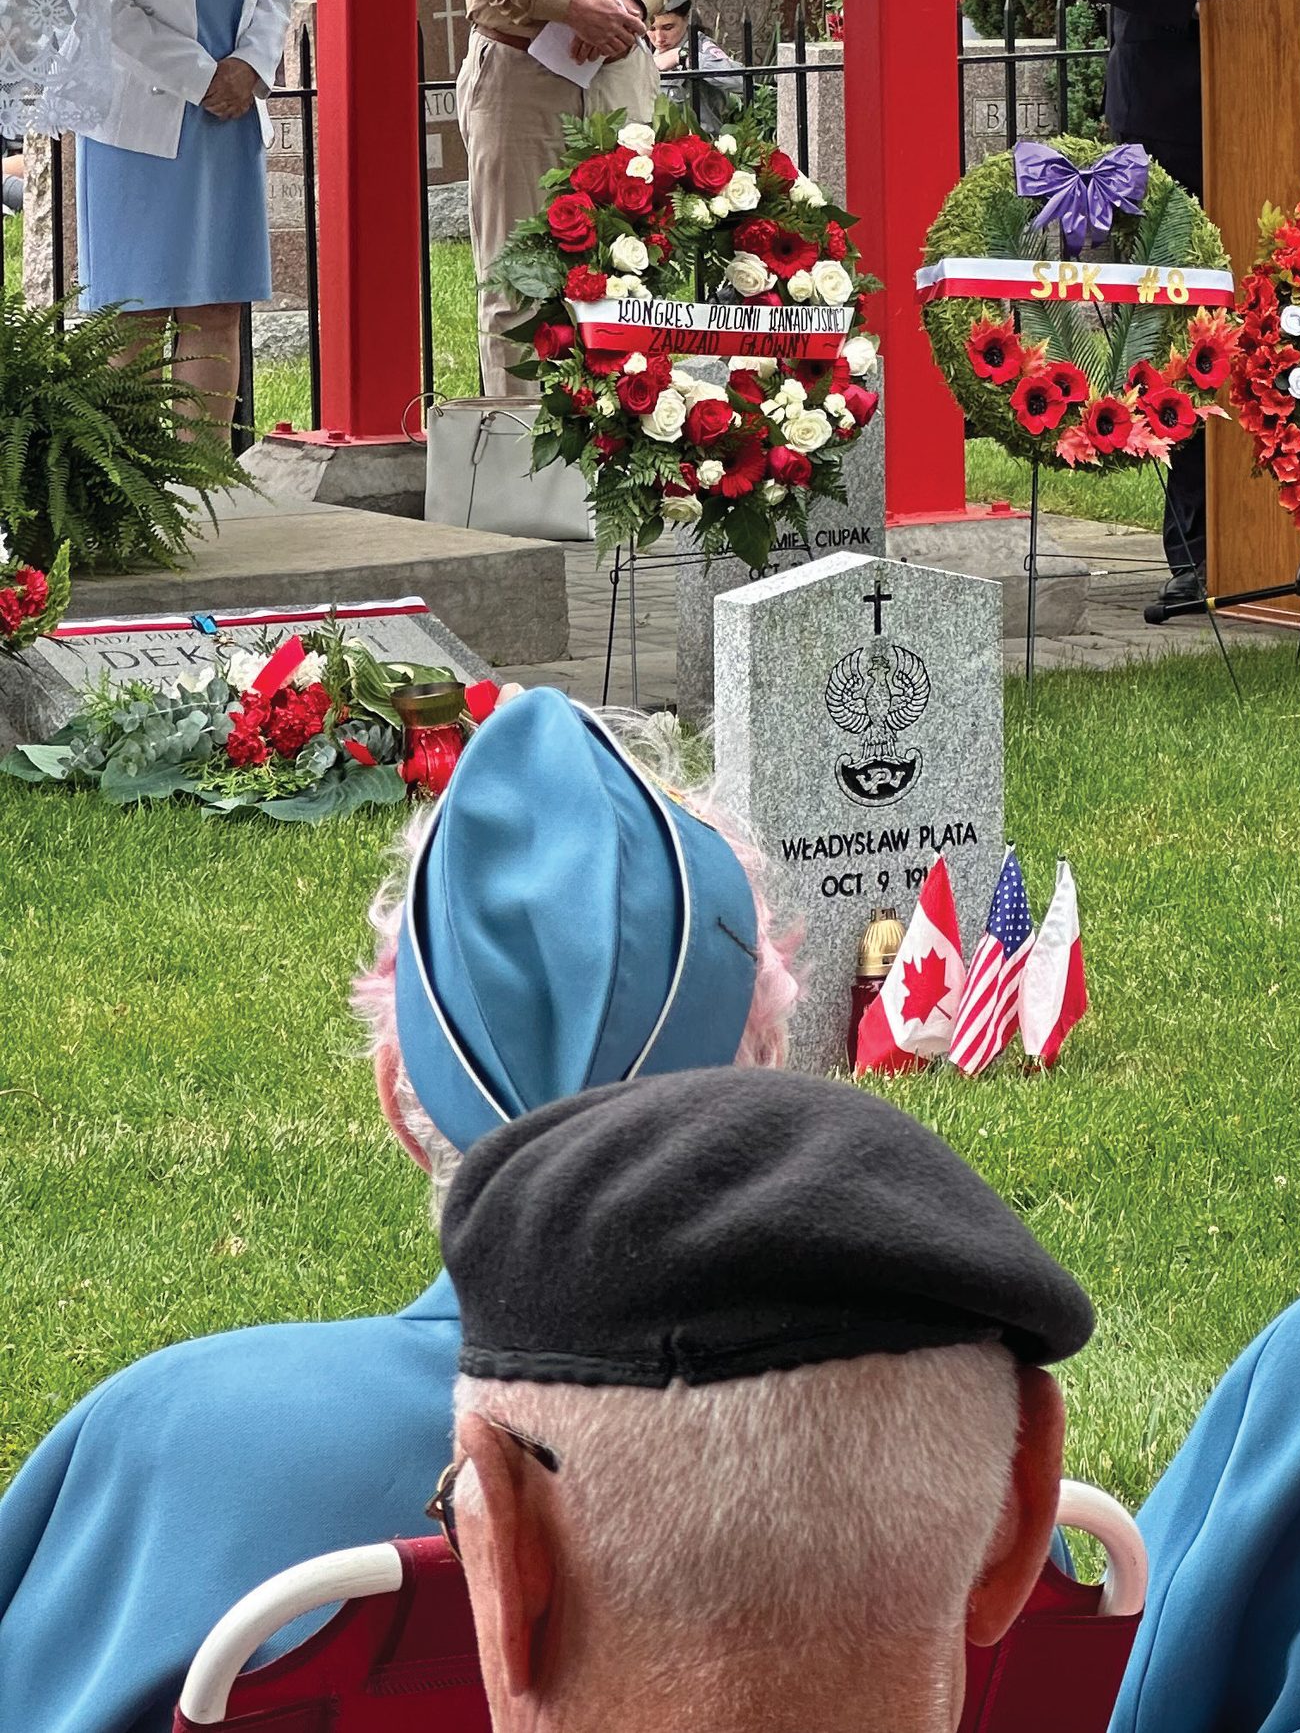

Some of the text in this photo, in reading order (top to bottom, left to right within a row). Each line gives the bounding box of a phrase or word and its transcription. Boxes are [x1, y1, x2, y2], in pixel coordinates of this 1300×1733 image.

[1030, 261, 1190, 305] SPK #8
[617, 299, 695, 329] KONGRES
[707, 304, 761, 332] POLONII
[815, 526, 871, 548] CIUPAK
[781, 821, 978, 862] WŁADYSŁAW PLATA
